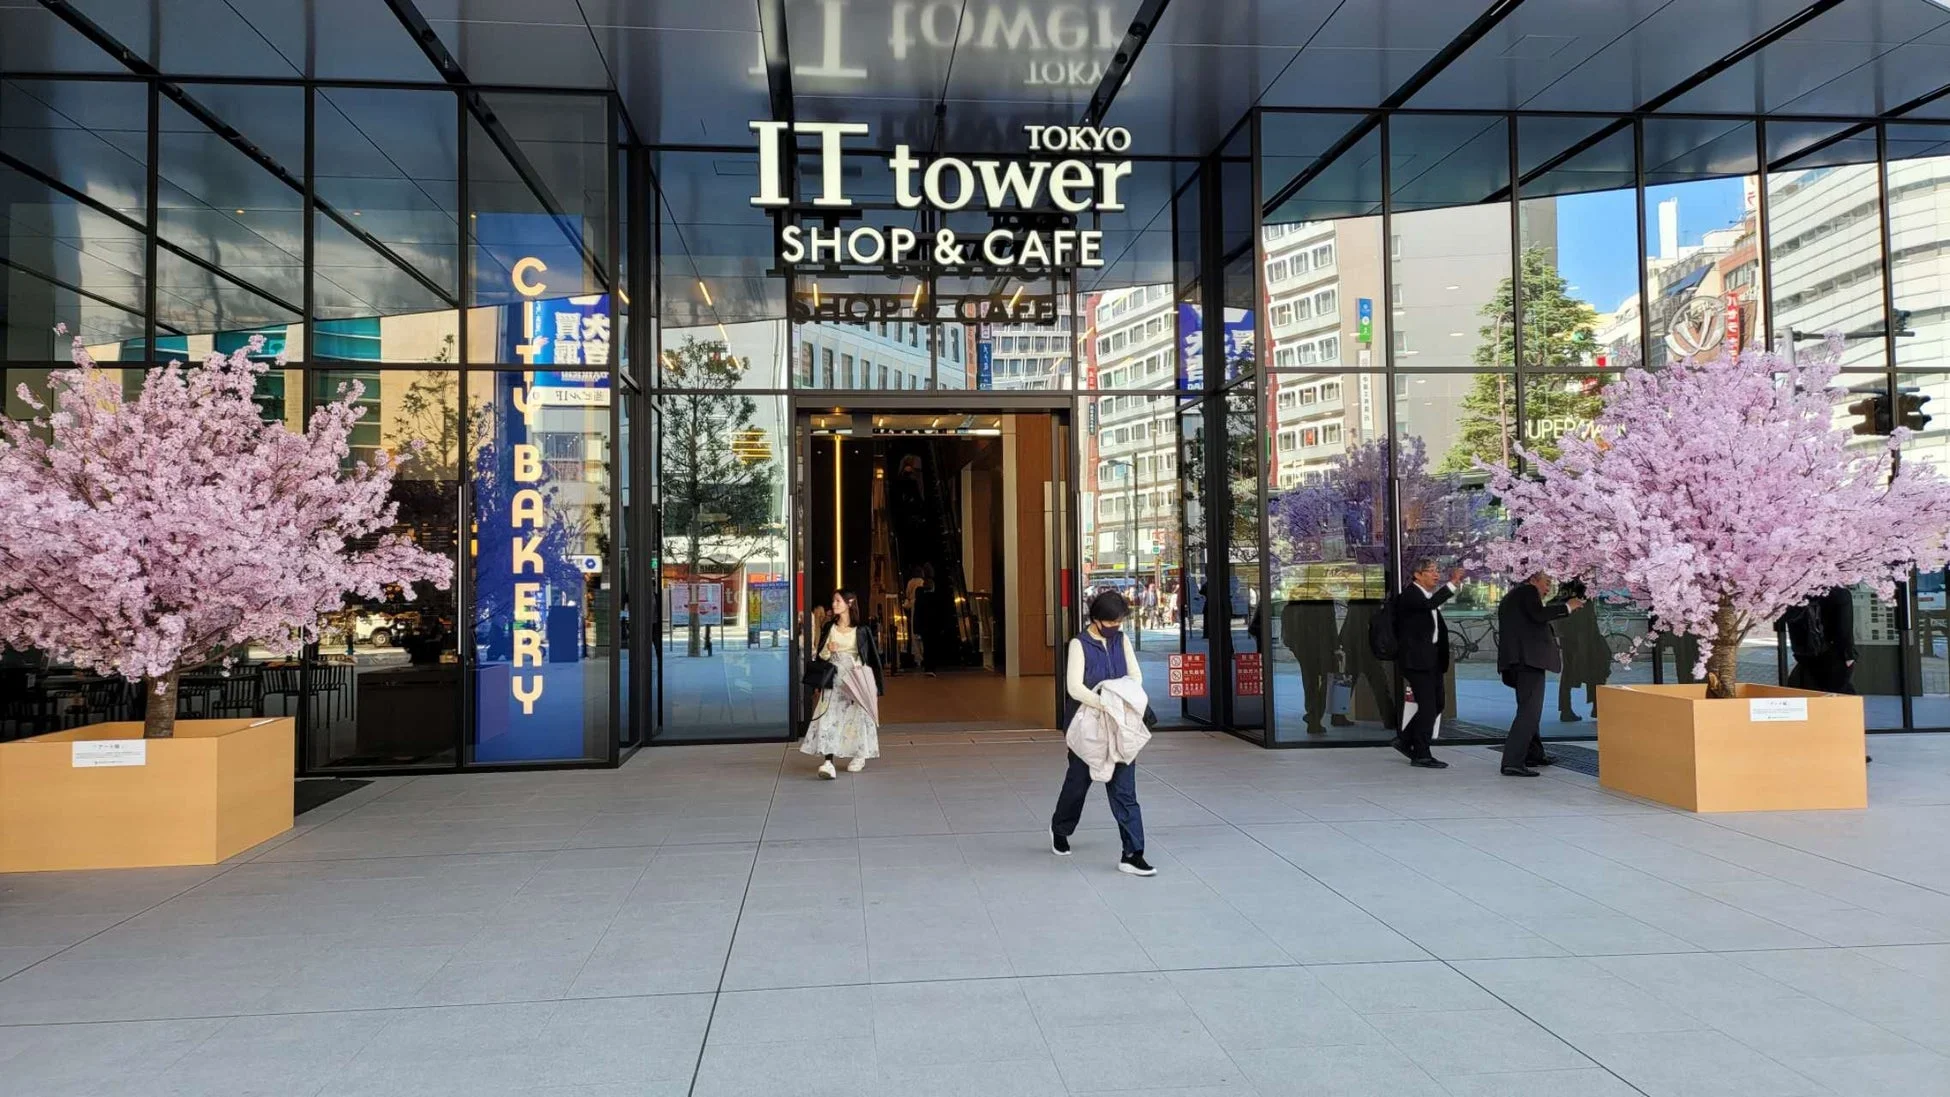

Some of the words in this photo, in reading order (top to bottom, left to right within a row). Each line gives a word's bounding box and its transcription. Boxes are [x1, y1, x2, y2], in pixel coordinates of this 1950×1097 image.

[749, 121, 869, 206] IT
[889, 144, 1132, 212] tower
[1024, 125, 1132, 151] TOKYO
[783, 225, 915, 264] SHOP
[935, 228, 965, 264] &
[984, 230, 1104, 267] CAFE
[512, 257, 547, 425] CITY
[1525, 419, 1575, 438] UPER
[511, 445, 545, 714] BAKERY
